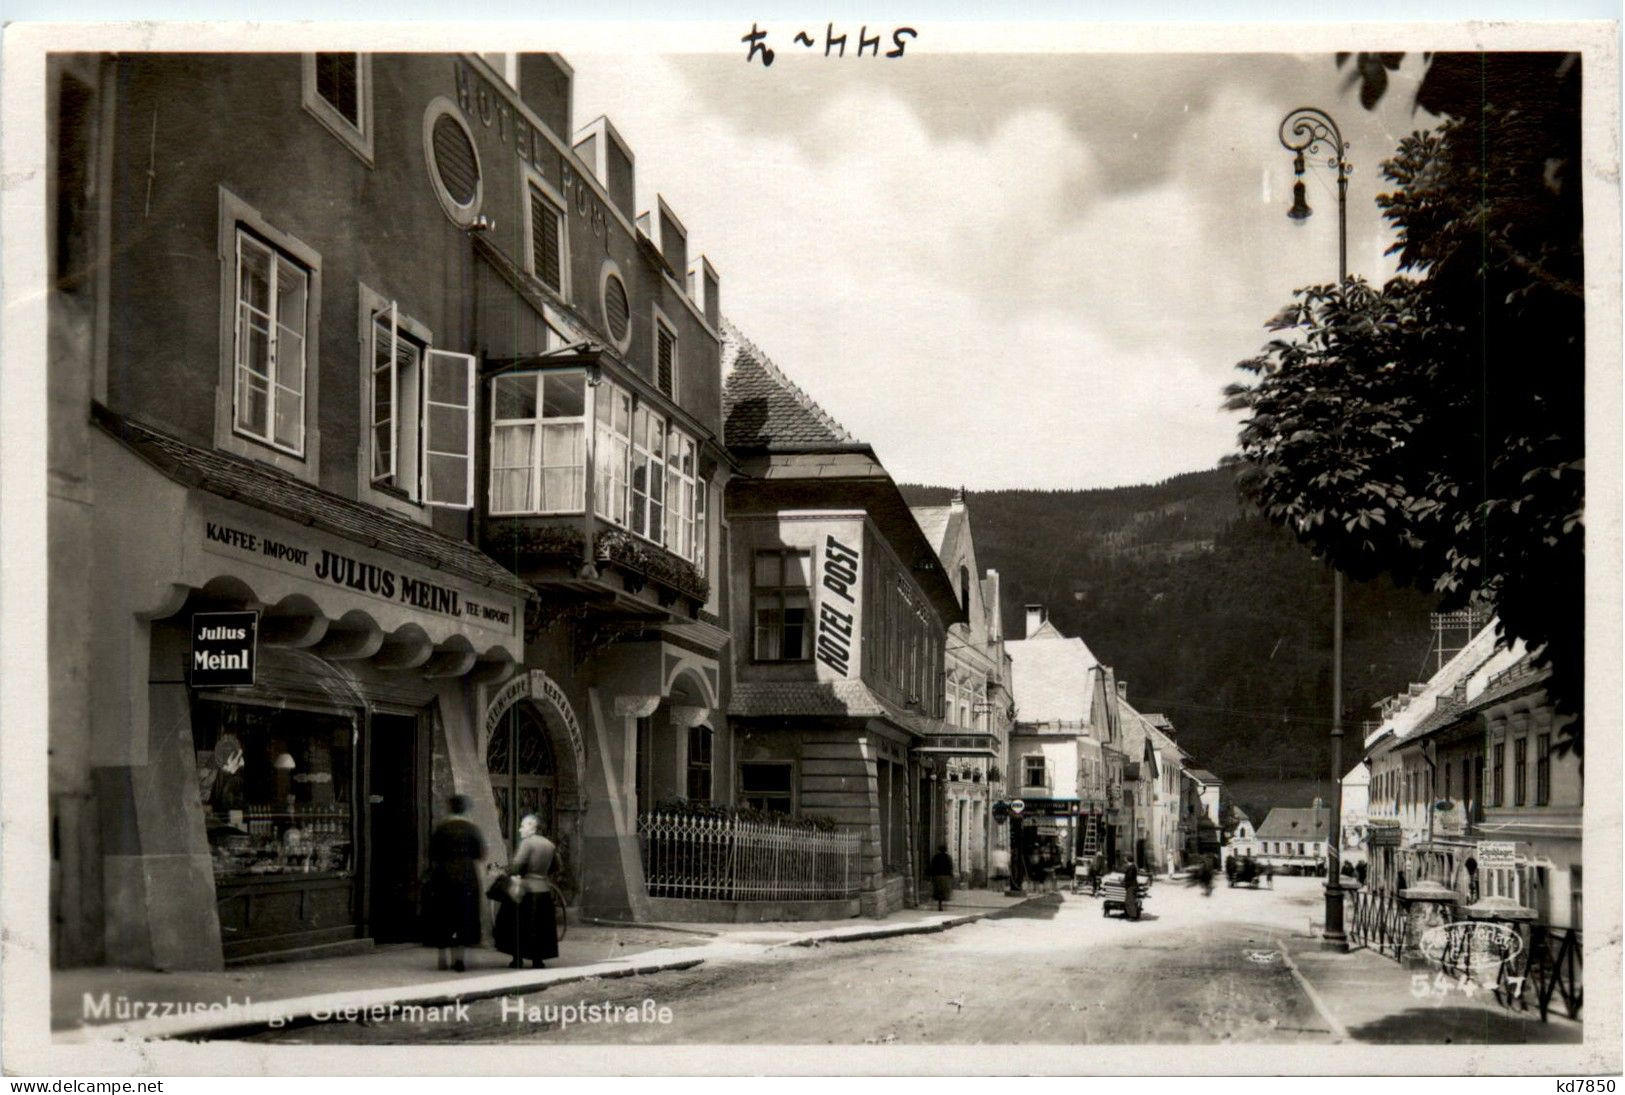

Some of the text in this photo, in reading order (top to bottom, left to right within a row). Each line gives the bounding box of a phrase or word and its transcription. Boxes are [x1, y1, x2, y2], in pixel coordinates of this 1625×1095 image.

[453, 60, 618, 257] HOTEL POST
[315, 550, 395, 599] JULIUS
[400, 575, 462, 618] MEINL
[816, 534, 859, 678] HOTEL POST
[194, 649, 249, 671] Meinl
[198, 626, 246, 641] Julius
